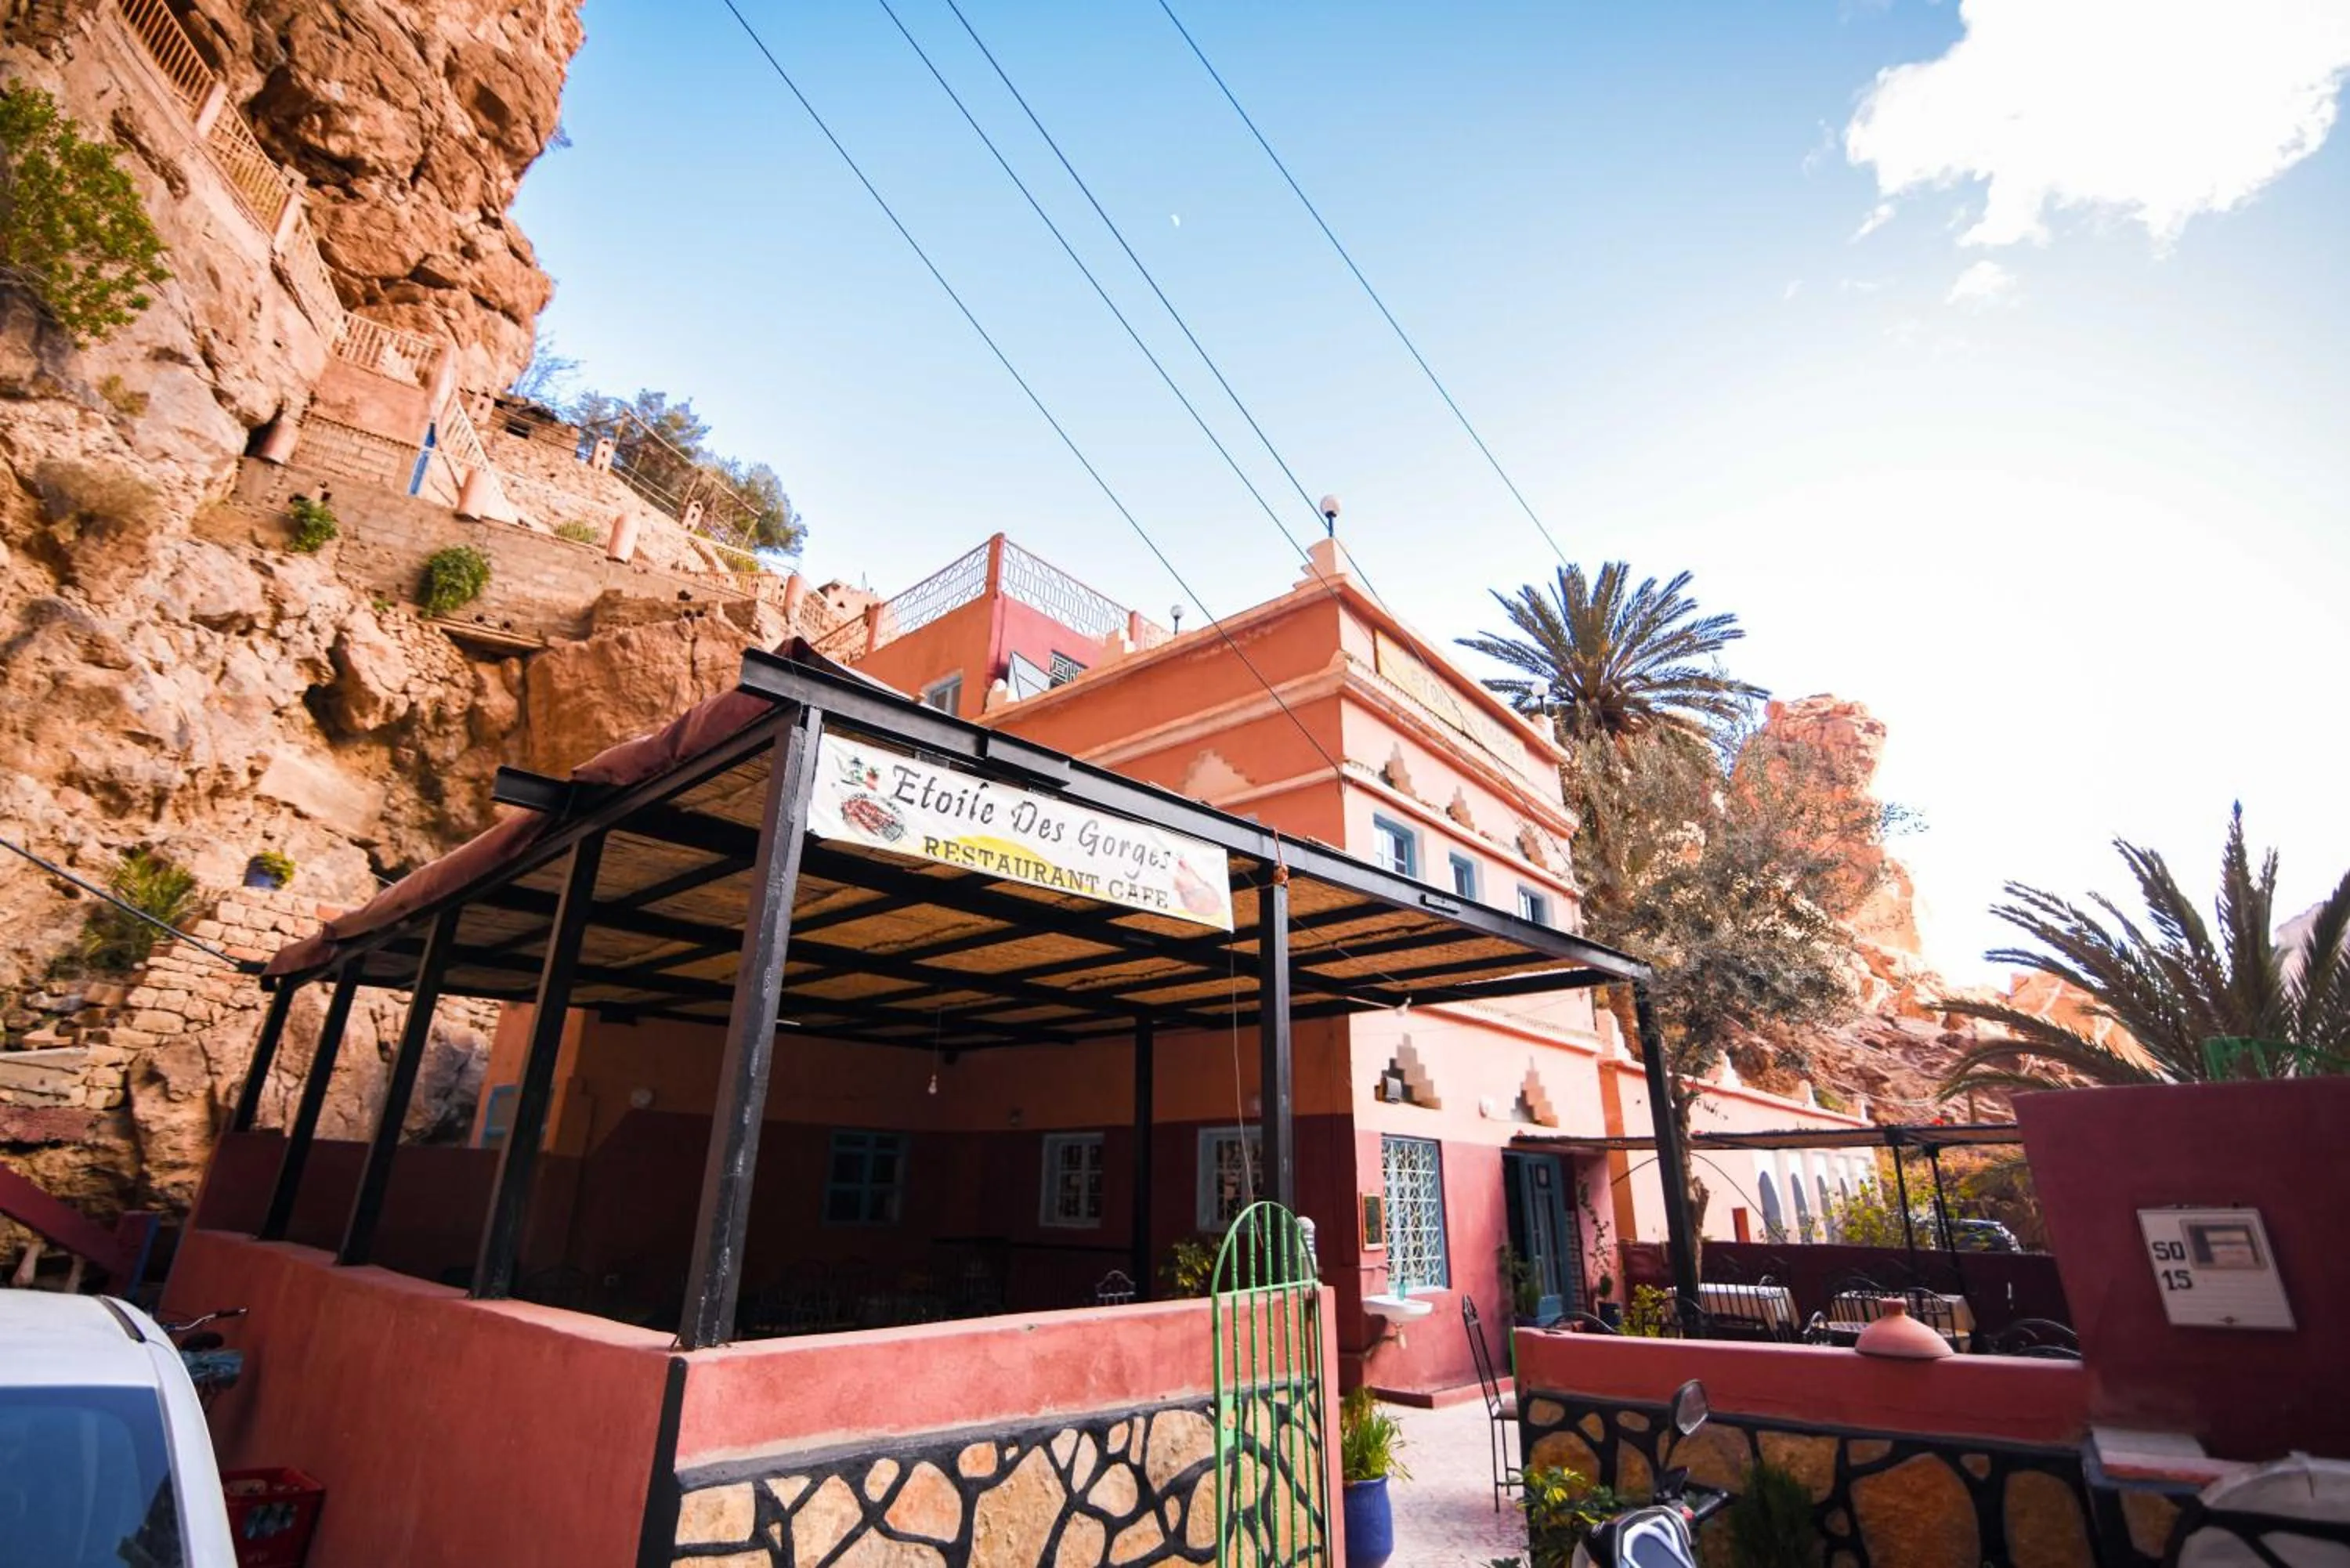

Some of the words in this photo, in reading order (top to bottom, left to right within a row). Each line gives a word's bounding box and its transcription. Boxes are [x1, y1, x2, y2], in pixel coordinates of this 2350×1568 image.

[892, 764, 994, 825] Etoile
[1010, 800, 1065, 843] Des
[1077, 819, 1172, 880] Gorges
[924, 835, 1101, 894] RESTAURANT
[1108, 879, 1169, 909] CAFE
[2161, 1269, 2193, 1291] 15
